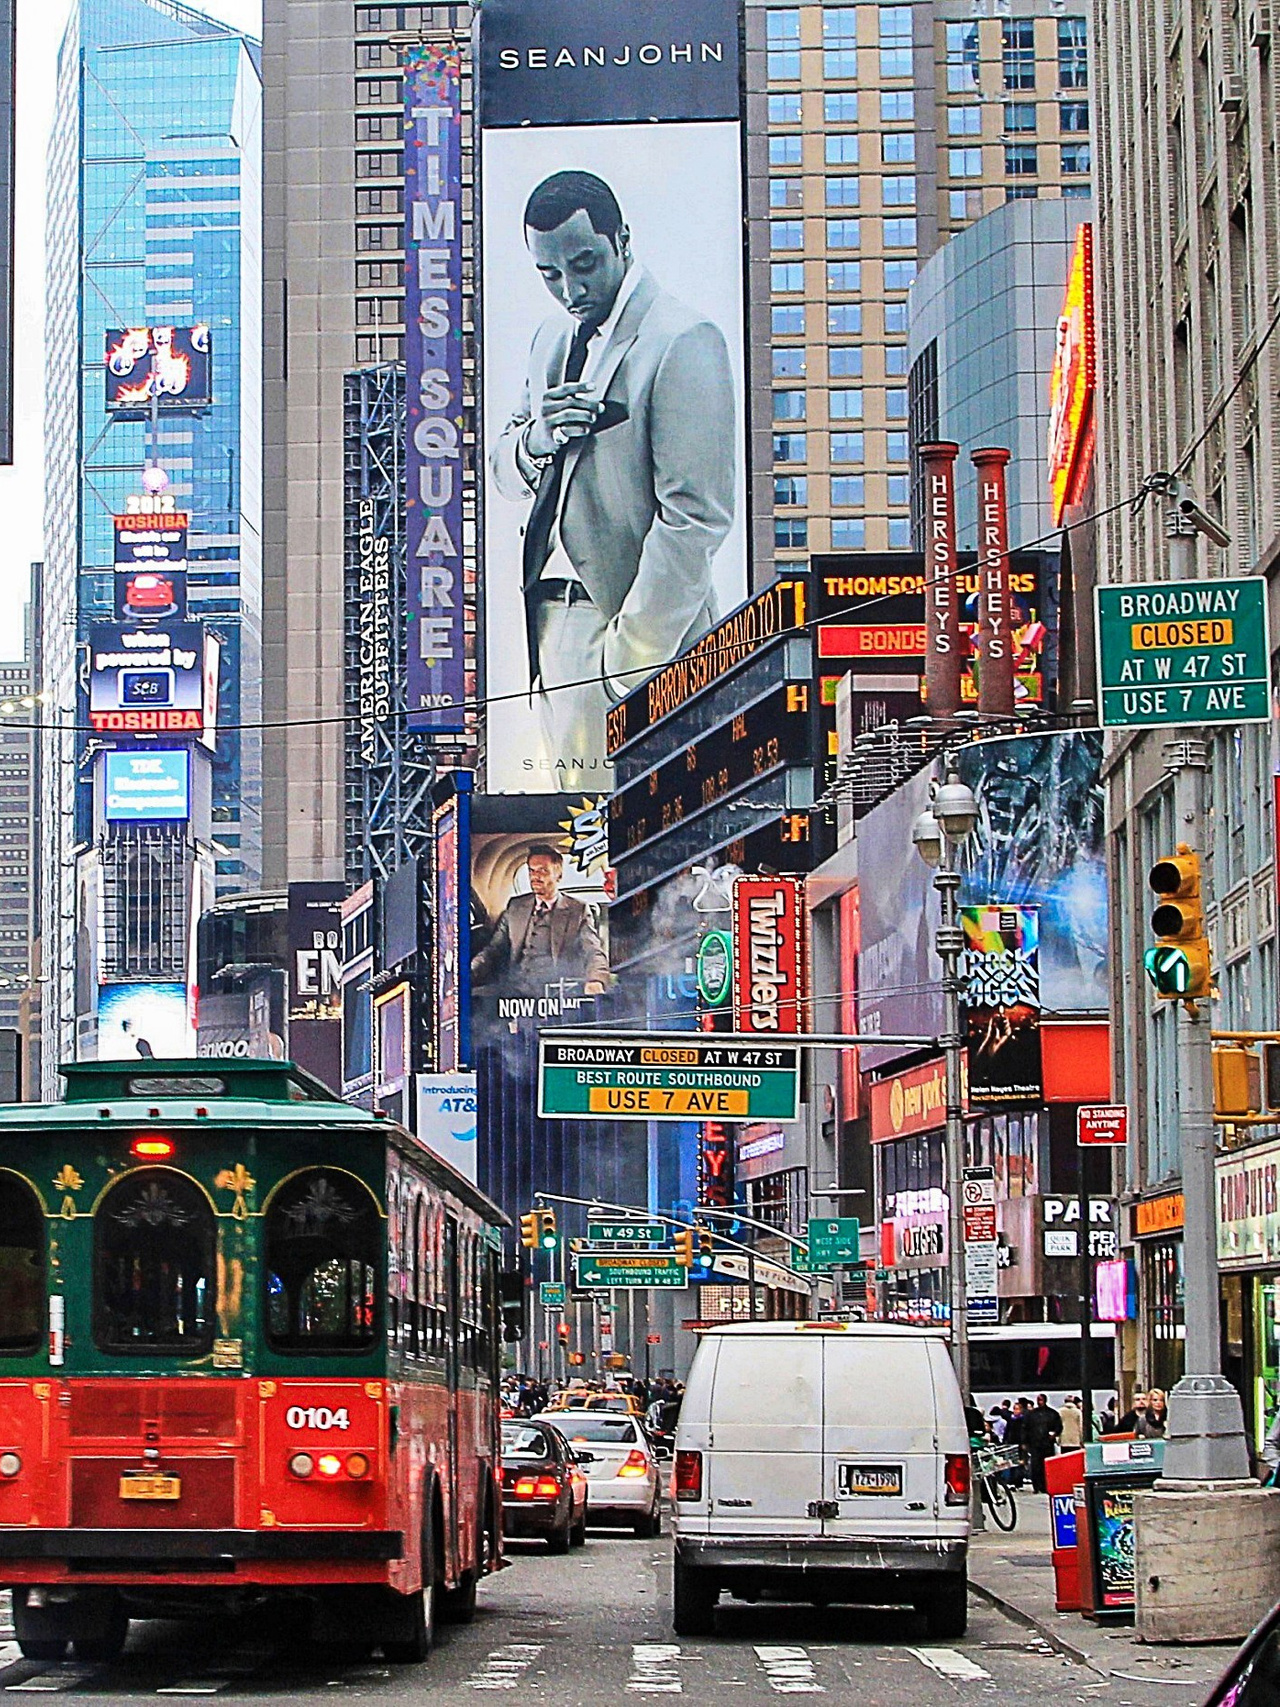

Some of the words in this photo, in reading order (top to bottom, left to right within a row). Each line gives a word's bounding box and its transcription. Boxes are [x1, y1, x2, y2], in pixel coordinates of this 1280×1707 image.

[126, 495, 176, 514] 2012
[114, 516, 188, 529] TOSHIBA
[360, 500, 376, 586] EAGLE
[1120, 589, 1240, 617] BROADWAY
[375, 536, 389, 721] OUTFITTERS
[1140, 621, 1225, 647] CLOSED
[173, 648, 197, 669] by
[1120, 659, 1145, 682] AT
[1155, 657, 1171, 680] W
[1182, 655, 1210, 678] 47
[1221, 653, 1247, 676] ST
[360, 594, 376, 765] AMERICAN
[1123, 691, 1168, 715] USE
[1179, 689, 1193, 712] 7
[1206, 687, 1246, 711] AVE
[90, 712, 202, 731] TOSHIBA
[313, 931, 341, 949] BO
[750, 890, 788, 1030] Twizzlers
[498, 998, 535, 1018] NOW
[557, 1048, 635, 1063] BROADWAY
[643, 1049, 696, 1063] CLOSED
[704, 1051, 722, 1064] AT
[727, 1051, 741, 1064] W
[742, 1051, 762, 1065] 47
[764, 1052, 783, 1065] ST
[576, 1071, 611, 1084] BEST
[616, 1072, 662, 1085] ROUTE
[668, 1073, 761, 1087] SOUTHBOUND
[608, 1091, 650, 1109] USE
[662, 1091, 675, 1110] 7
[686, 1092, 729, 1111] AVE
[904, 1085, 921, 1117] new
[1081, 1109, 1090, 1119] NO
[1092, 1109, 1125, 1118] STANDING
[1085, 1120, 1120, 1129] ANYTIME
[602, 1227, 613, 1237] W
[616, 1227, 634, 1238] 49
[637, 1227, 651, 1239] St
[608, 1268, 652, 1276] SOUTHBOUND
[654, 1268, 680, 1276] TRAFFIC
[286, 1406, 350, 1430] 0104
